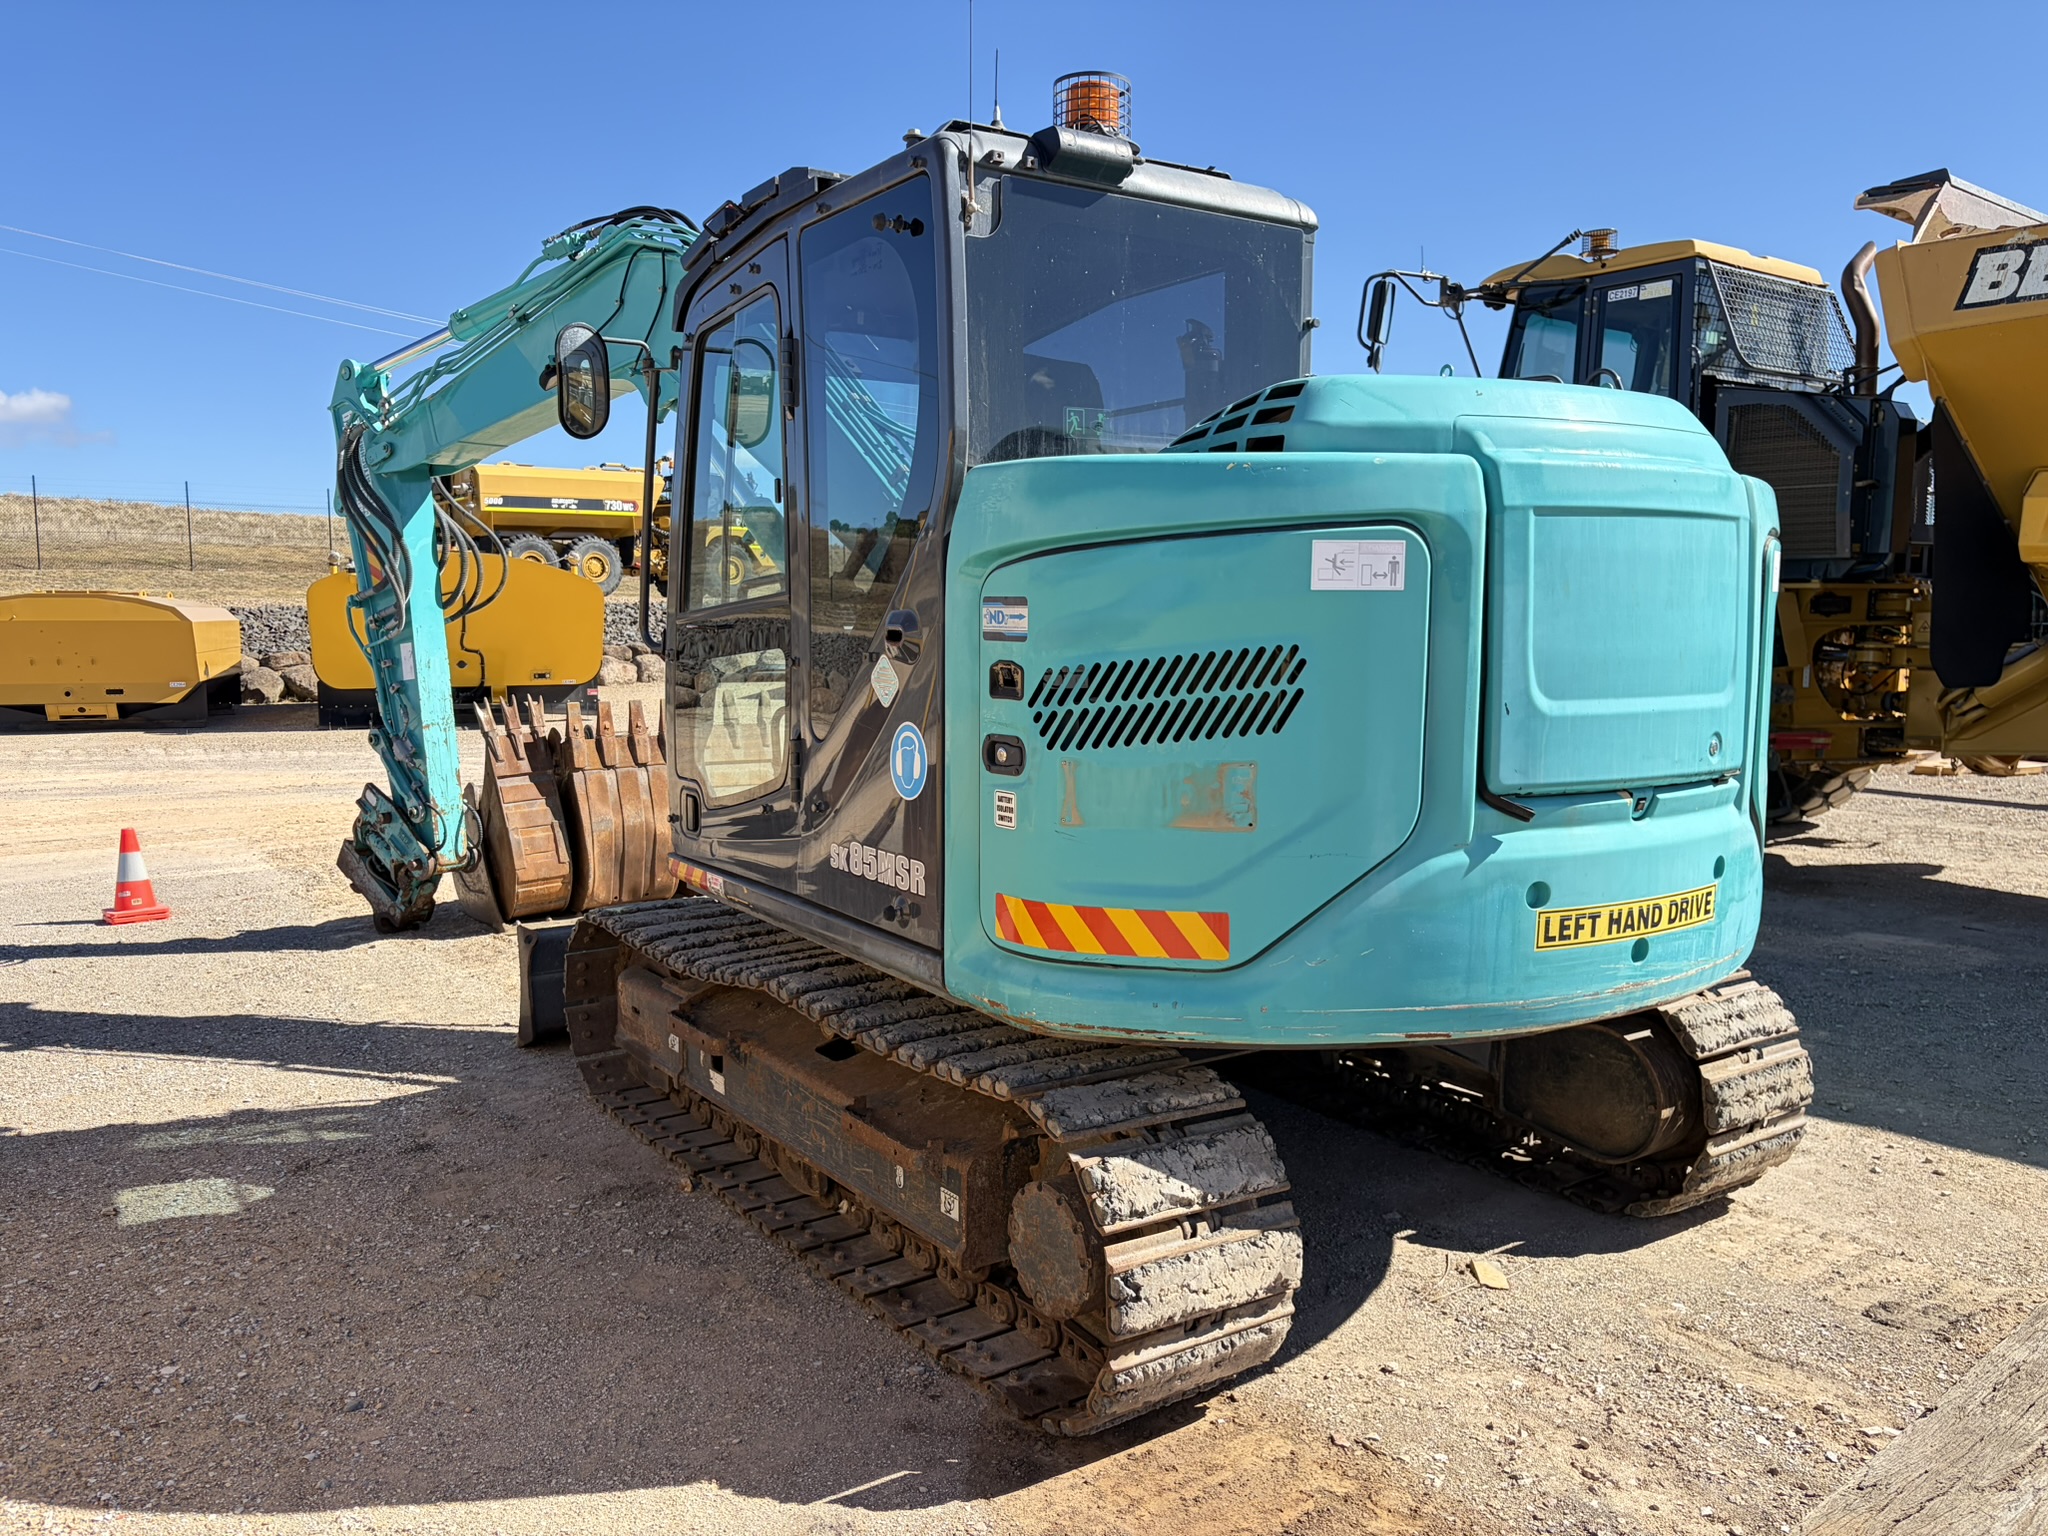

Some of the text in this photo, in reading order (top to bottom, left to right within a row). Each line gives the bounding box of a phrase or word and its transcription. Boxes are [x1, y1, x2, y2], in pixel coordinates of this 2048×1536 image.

[1608, 287, 1637, 300] CE2197
[997, 805, 1013, 814] ISOLATOR
[998, 814, 1012, 823] SWITCH
[1543, 891, 1713, 943] LEFT HAND DRIVE
